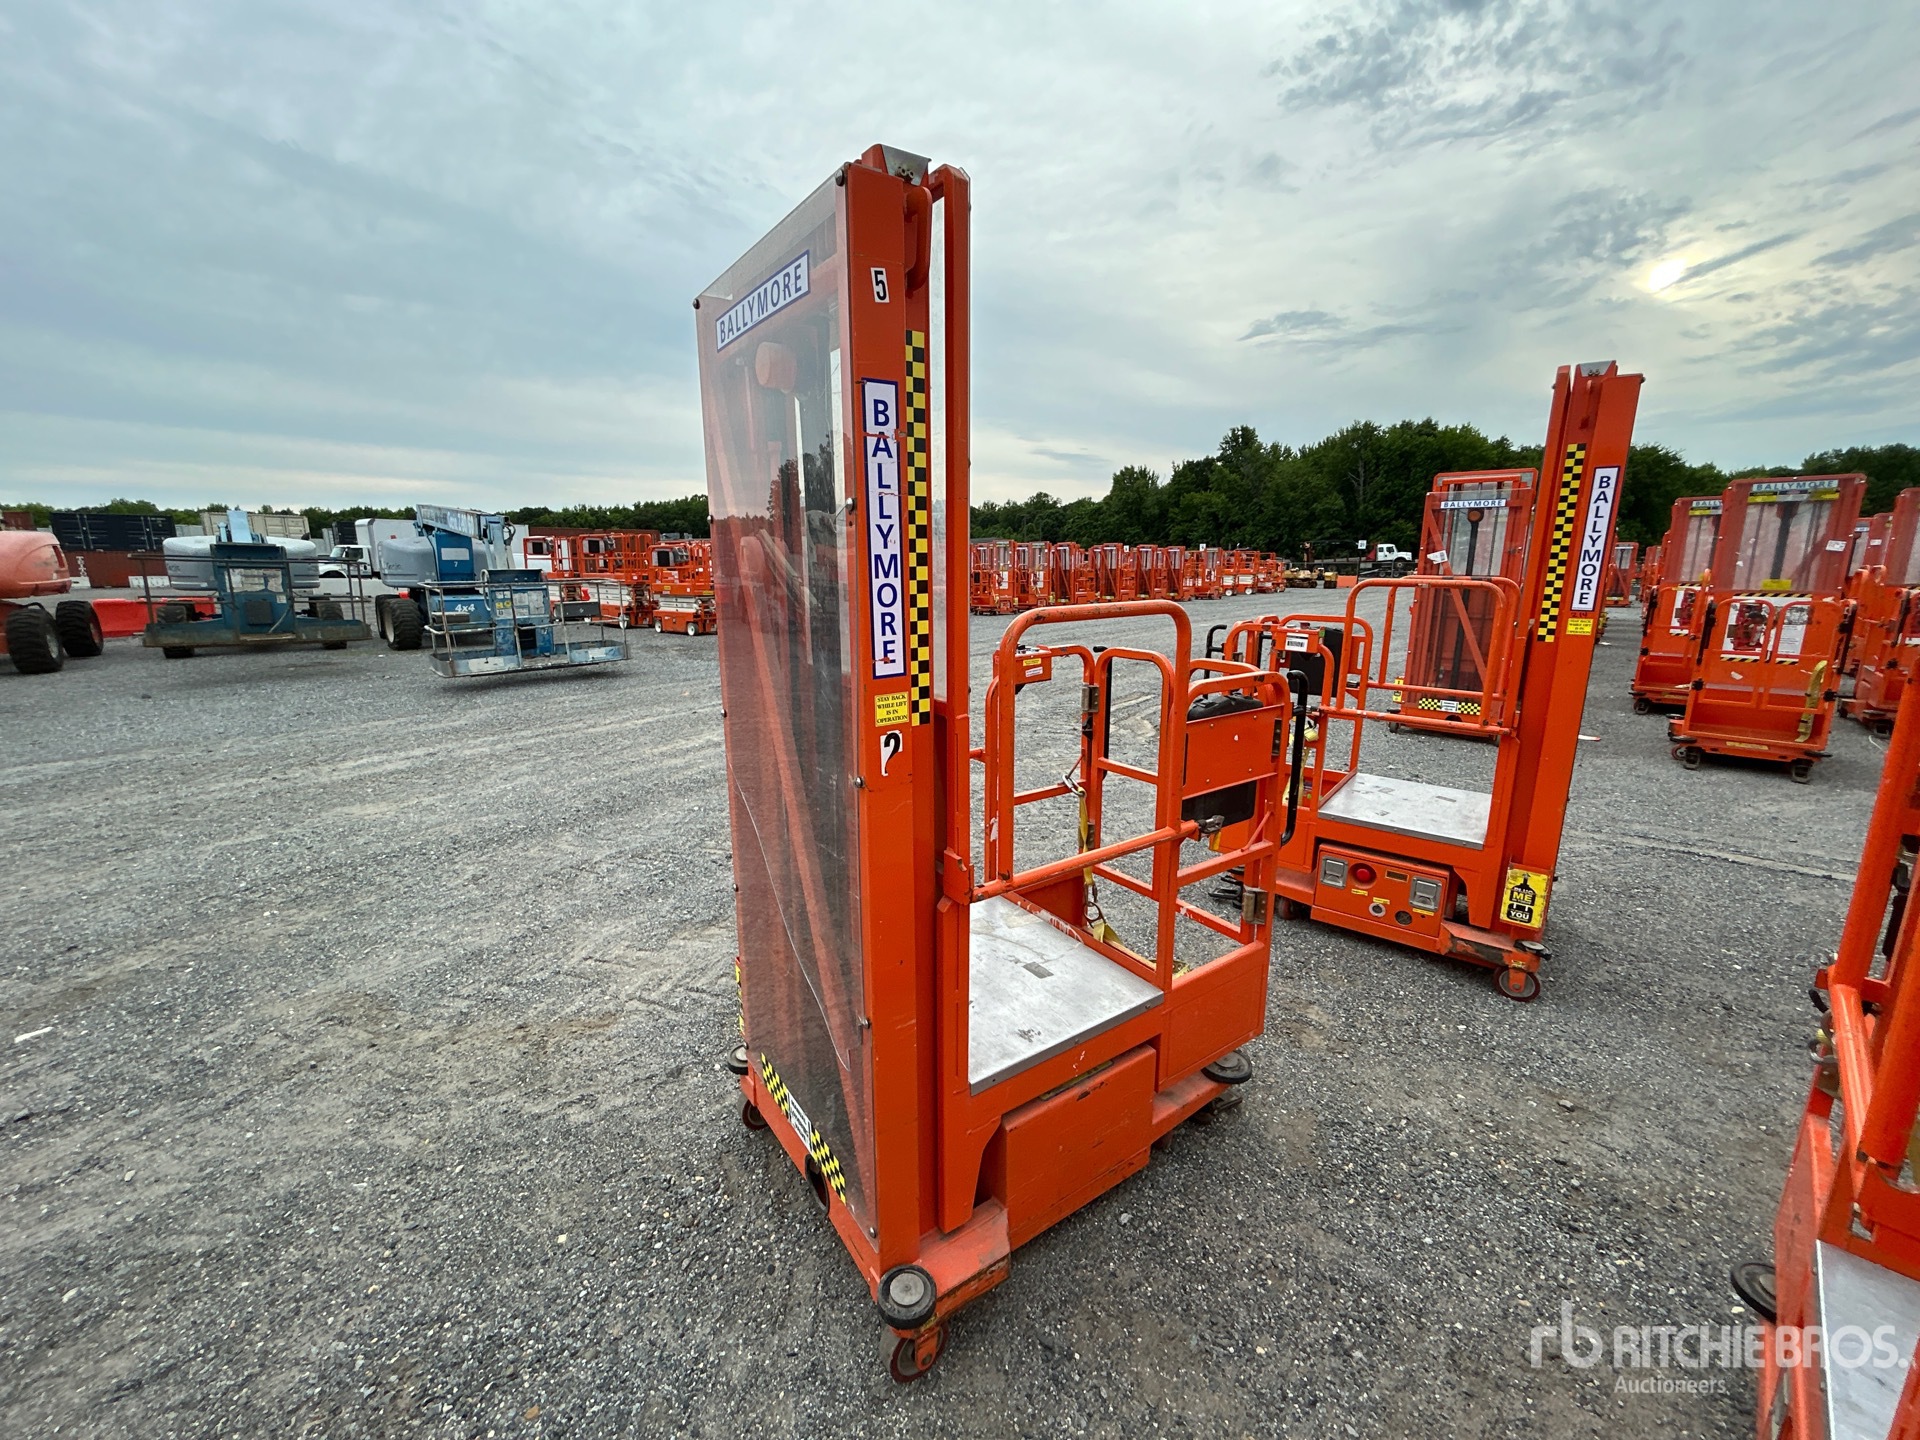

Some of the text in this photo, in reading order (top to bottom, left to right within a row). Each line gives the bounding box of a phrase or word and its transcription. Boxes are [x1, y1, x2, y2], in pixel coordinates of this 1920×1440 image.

[873, 269, 887, 301] 5
[720, 262, 803, 344] BALLYMORE
[1755, 480, 1834, 491] BALLYMORE
[871, 398, 899, 664] BALLYMORE
[1578, 475, 1611, 605] BALLYMORE
[454, 603, 476, 612] 4x4
[877, 714, 908, 723] OPERATION
[1513, 891, 1533, 901] ME
[1510, 911, 1529, 919] YOU
